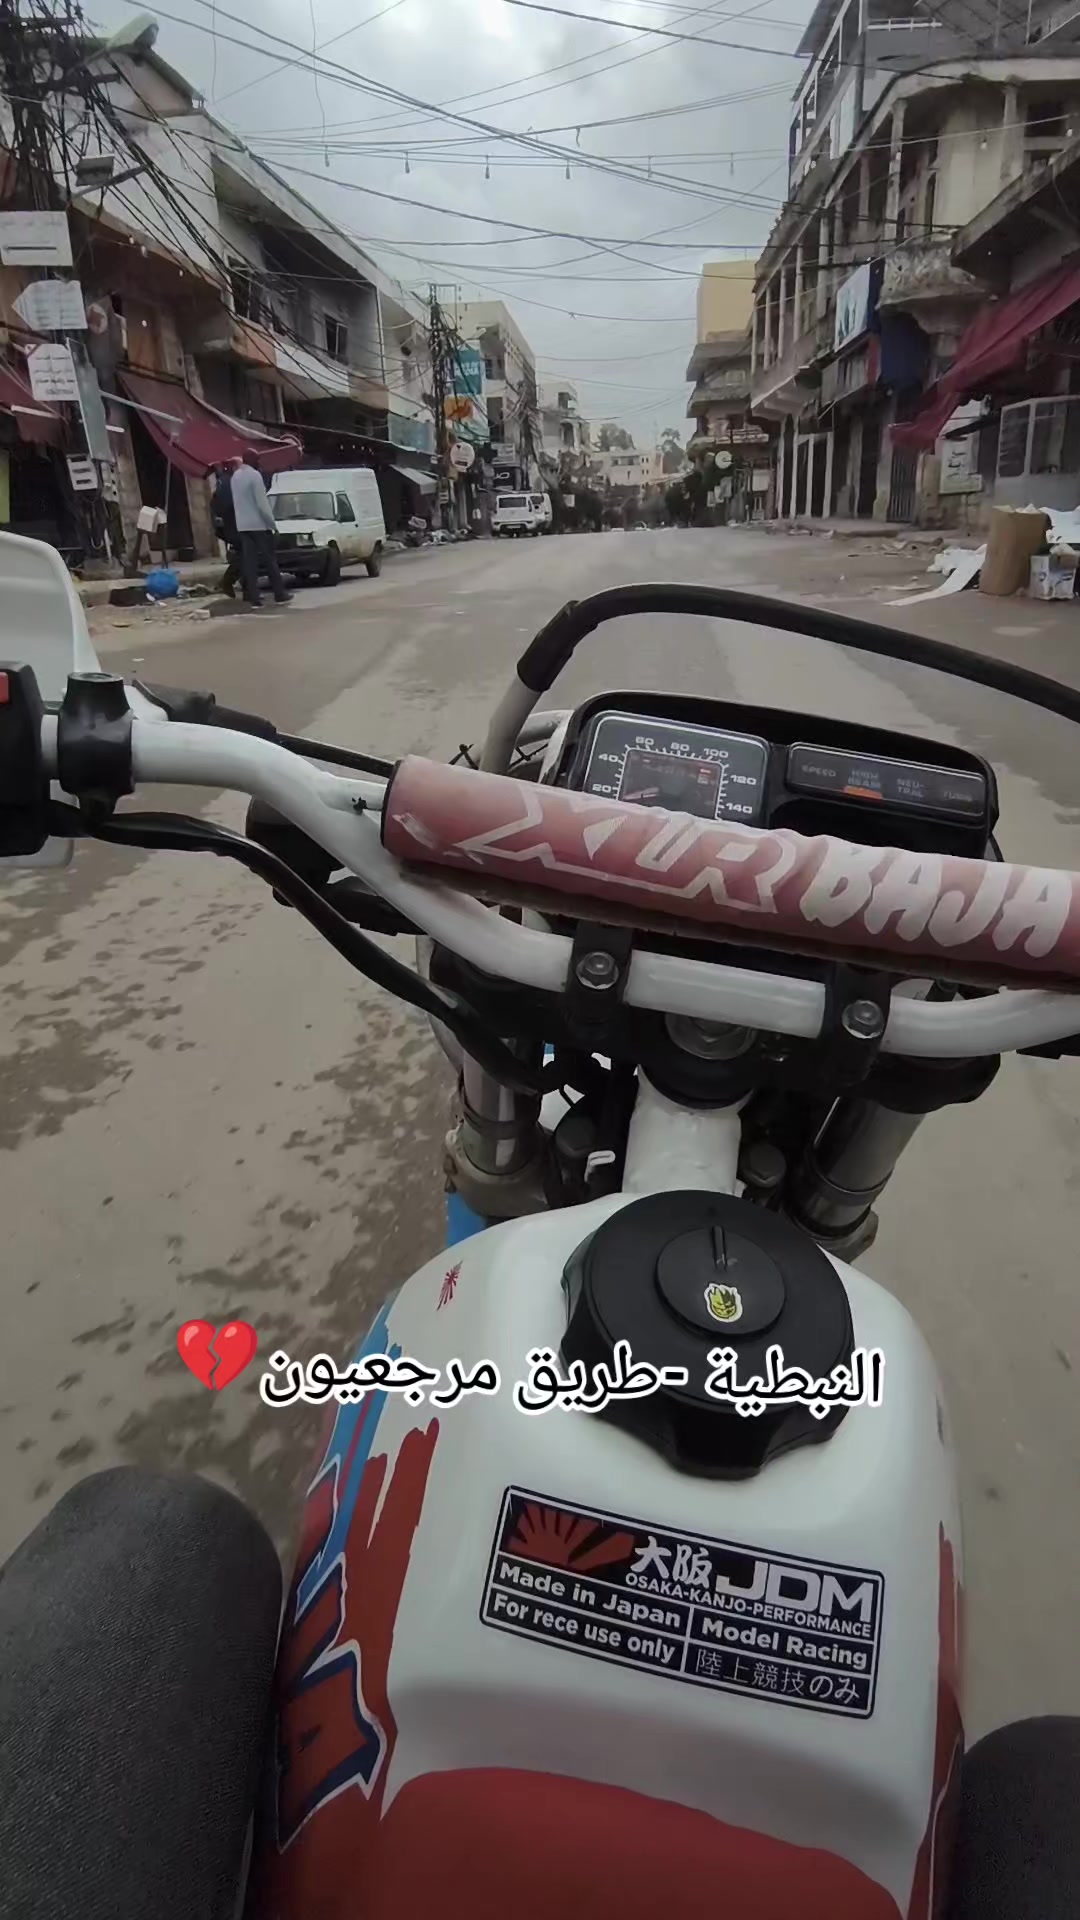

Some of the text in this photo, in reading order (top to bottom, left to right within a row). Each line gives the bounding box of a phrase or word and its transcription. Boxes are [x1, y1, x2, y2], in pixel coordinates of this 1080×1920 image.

[635, 736, 655, 747] 60
[671, 742, 690, 752] 80
[598, 753, 619, 764] 40
[703, 747, 729, 759] 100
[802, 764, 837, 777] SPEED
[730, 774, 757, 786] 120
[592, 783, 612, 794] 20
[726, 802, 753, 815] 140
[799, 834, 1073, 958] BAJA
[630, 1535, 874, 1623] 大阪 JDM
[499, 1562, 682, 1628] Made in Japan
[625, 1572, 872, 1638] OSAKA-KANJO-PERFORMANCE
[493, 1592, 676, 1664] For rece use only
[702, 1617, 868, 1671] Model Racing
[695, 1648, 861, 1705] 陸上競技のみ
